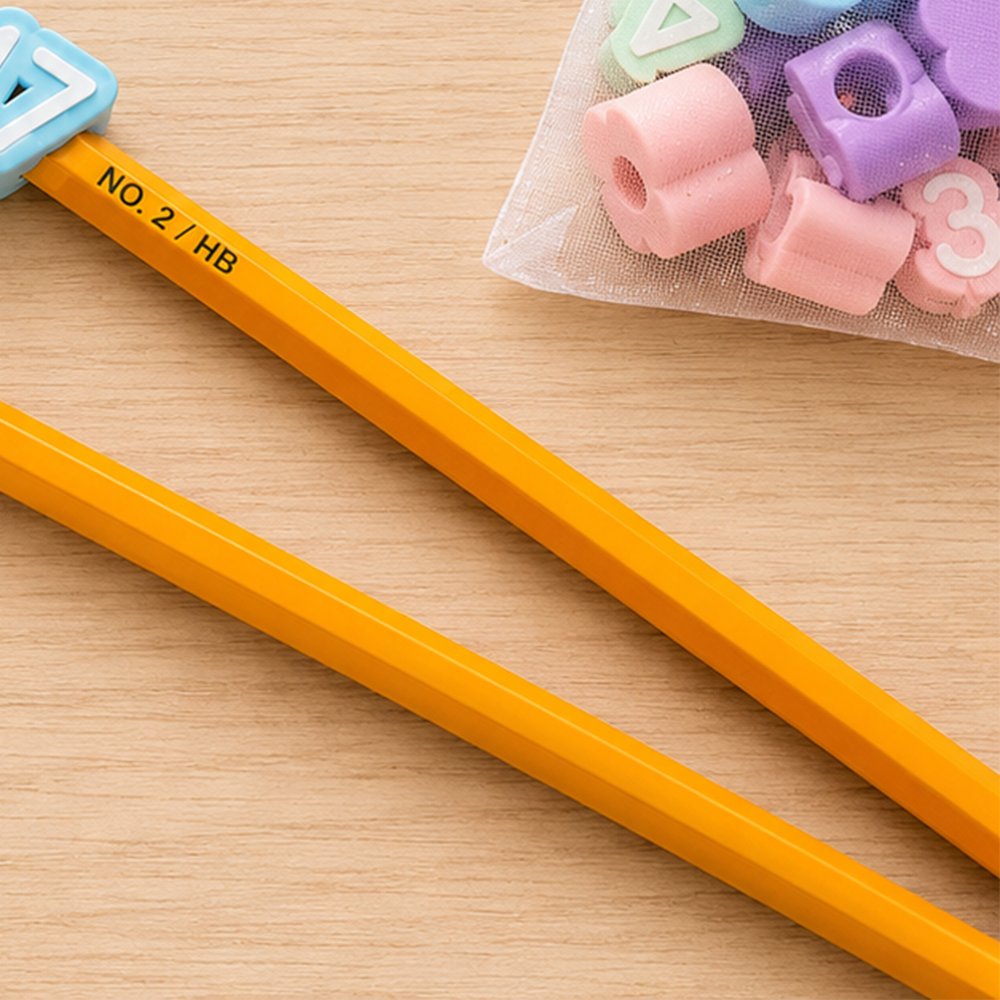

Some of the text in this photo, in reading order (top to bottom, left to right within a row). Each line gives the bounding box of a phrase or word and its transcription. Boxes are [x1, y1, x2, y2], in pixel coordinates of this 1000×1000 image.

[96, 166, 238, 275] NO. 2 / HB
[923, 172, 1000, 278] 3
